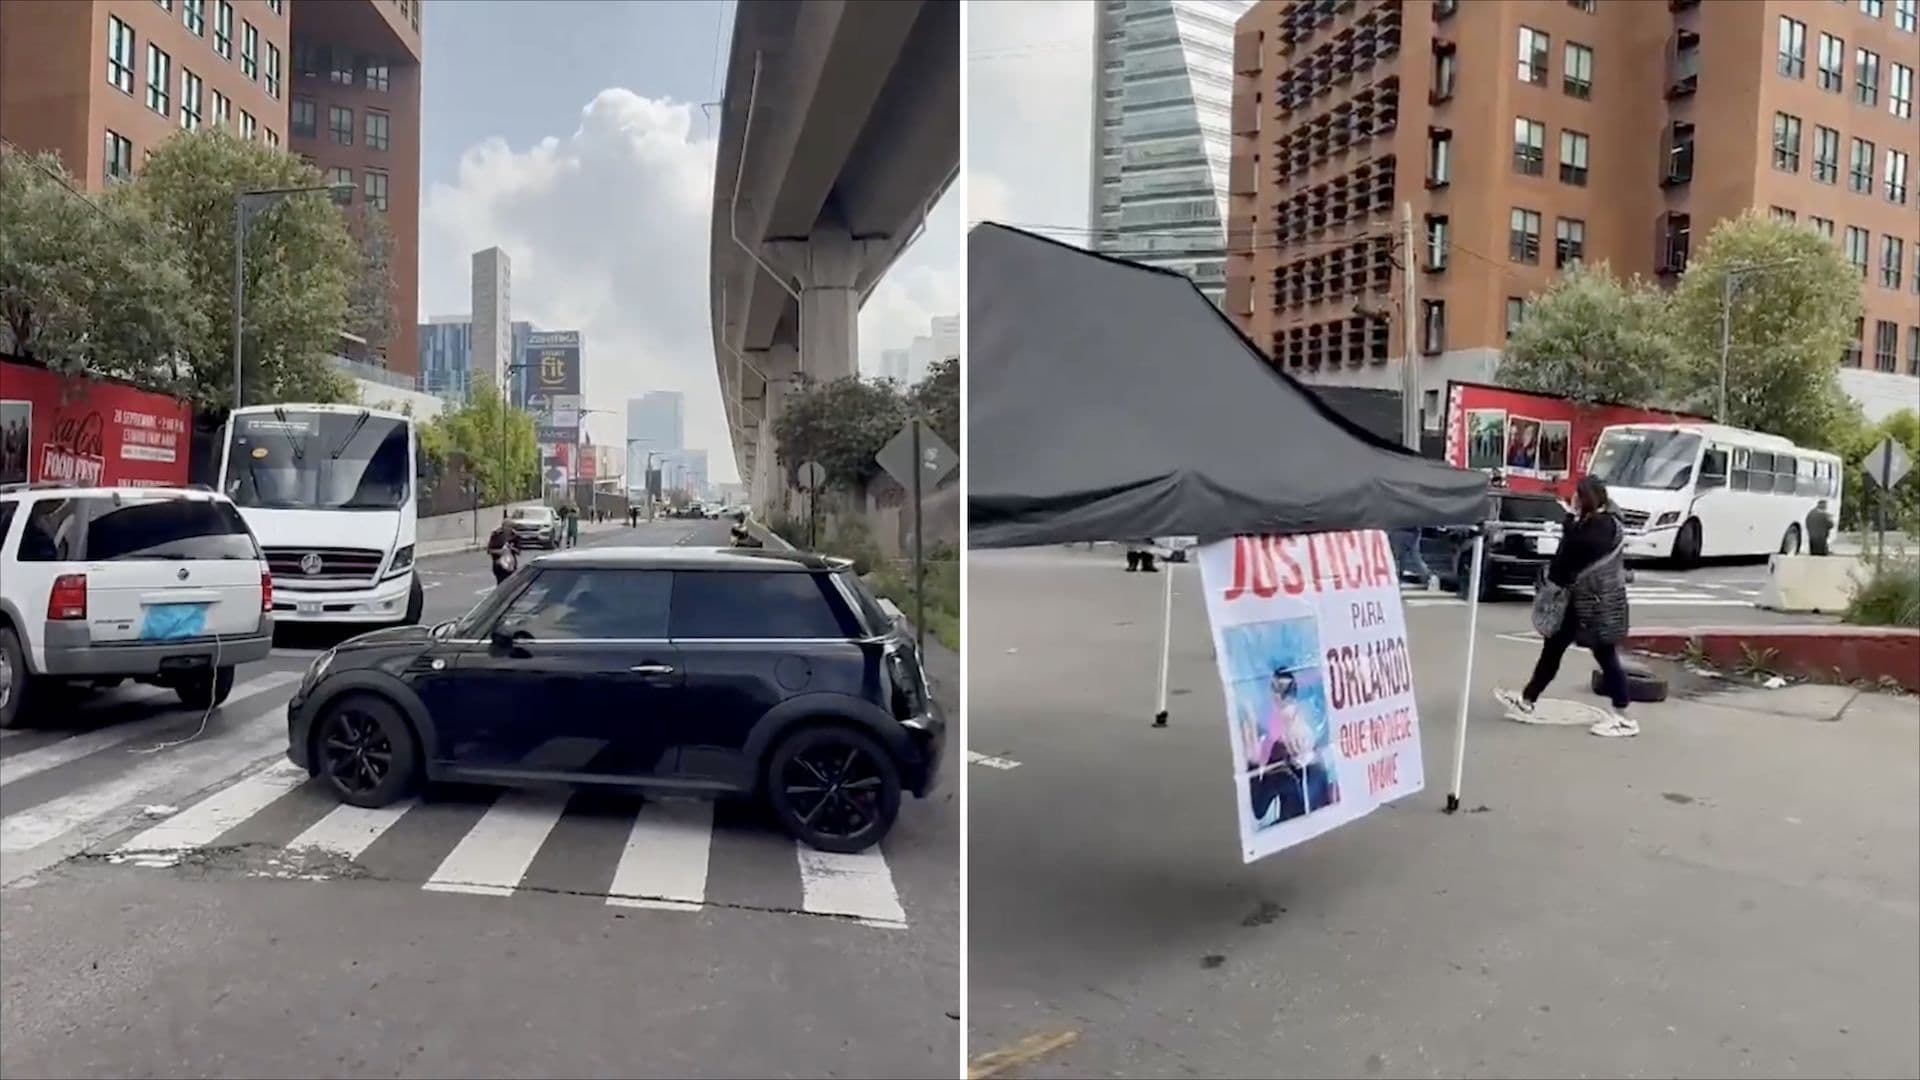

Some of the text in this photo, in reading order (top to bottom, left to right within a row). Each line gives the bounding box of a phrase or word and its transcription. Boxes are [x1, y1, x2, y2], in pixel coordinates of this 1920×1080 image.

[542, 357, 565, 377] fit
[44, 450, 102, 487] FOOD FEST
[1225, 531, 1392, 600] JUSTICIA
[1351, 601, 1385, 629] PARA
[1327, 637, 1410, 709] ORLANDO
[1340, 720, 1367, 758] QUE
